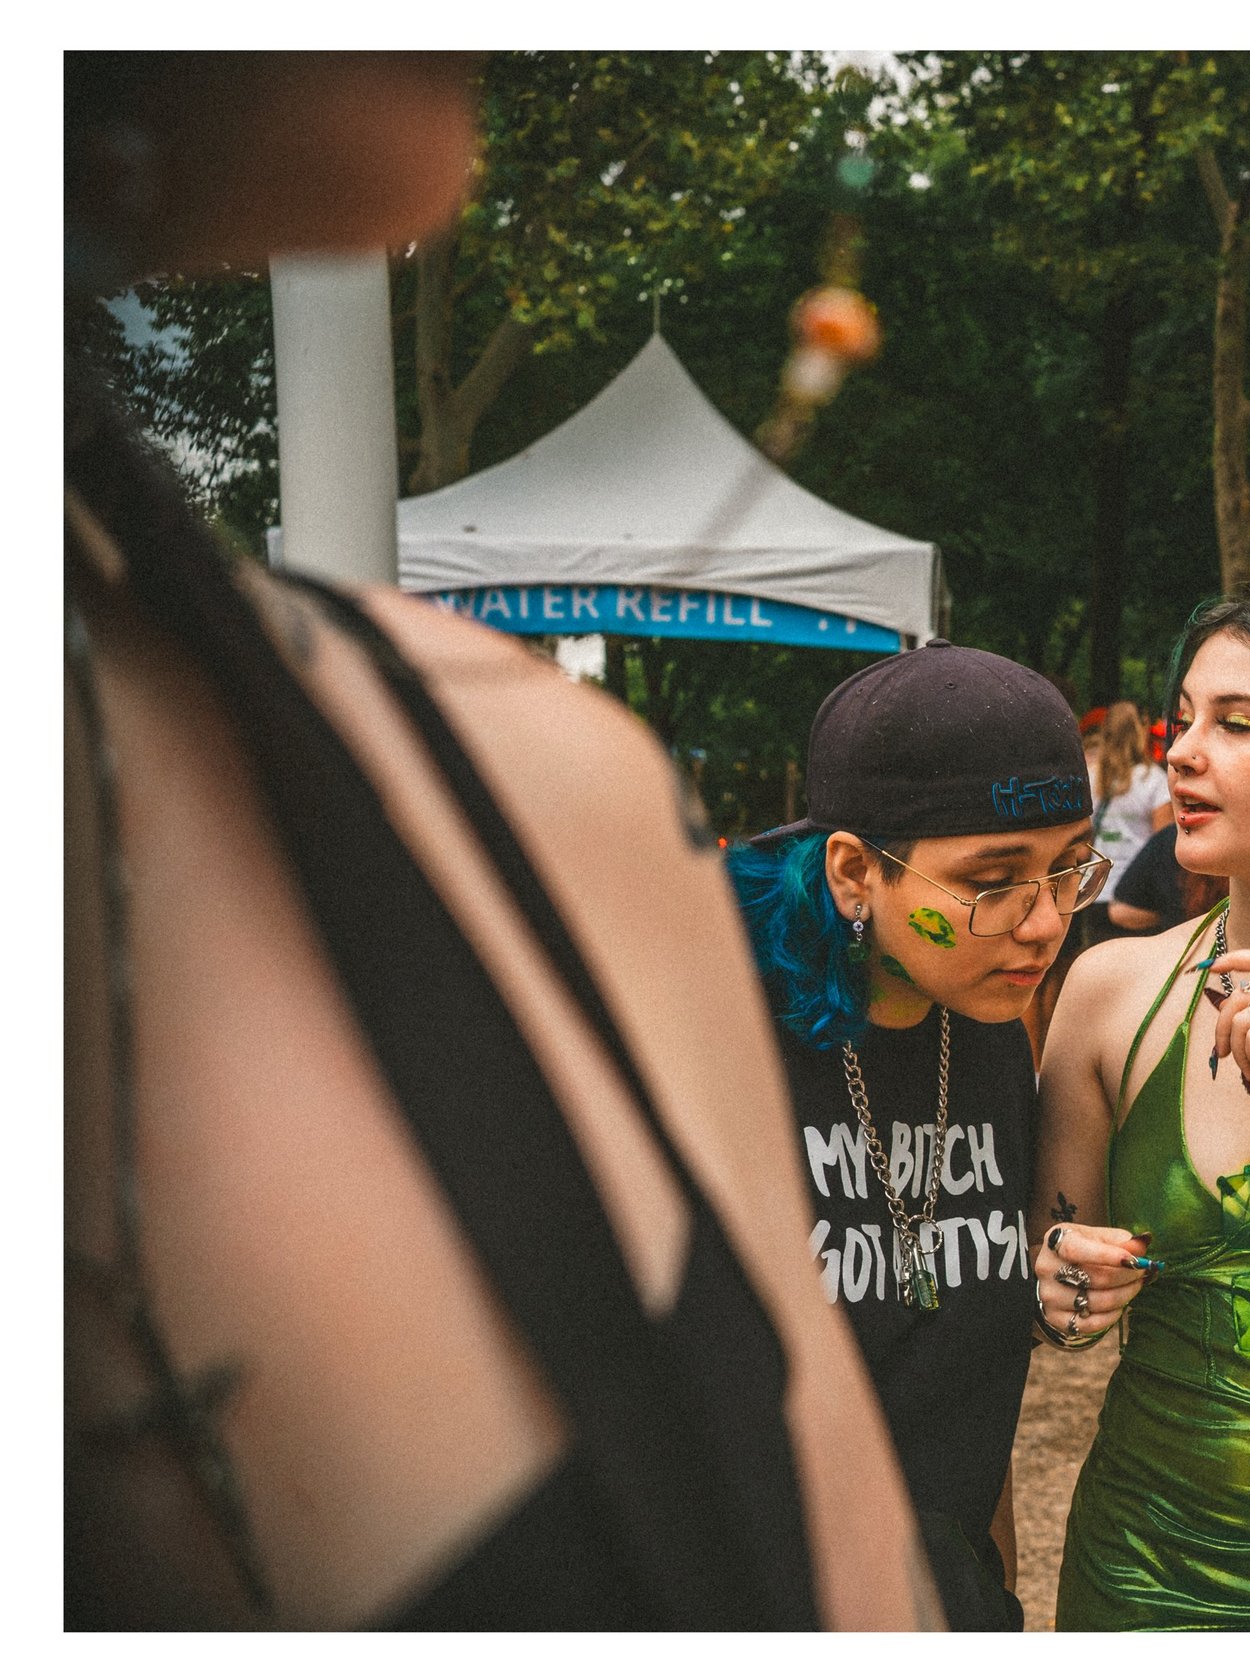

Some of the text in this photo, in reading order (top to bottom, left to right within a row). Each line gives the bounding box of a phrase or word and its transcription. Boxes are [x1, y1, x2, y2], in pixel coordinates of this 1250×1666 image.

[616, 584, 773, 628] REFILL
[803, 1121, 1004, 1199] MY BITCH
[808, 1219, 886, 1305] GOT
